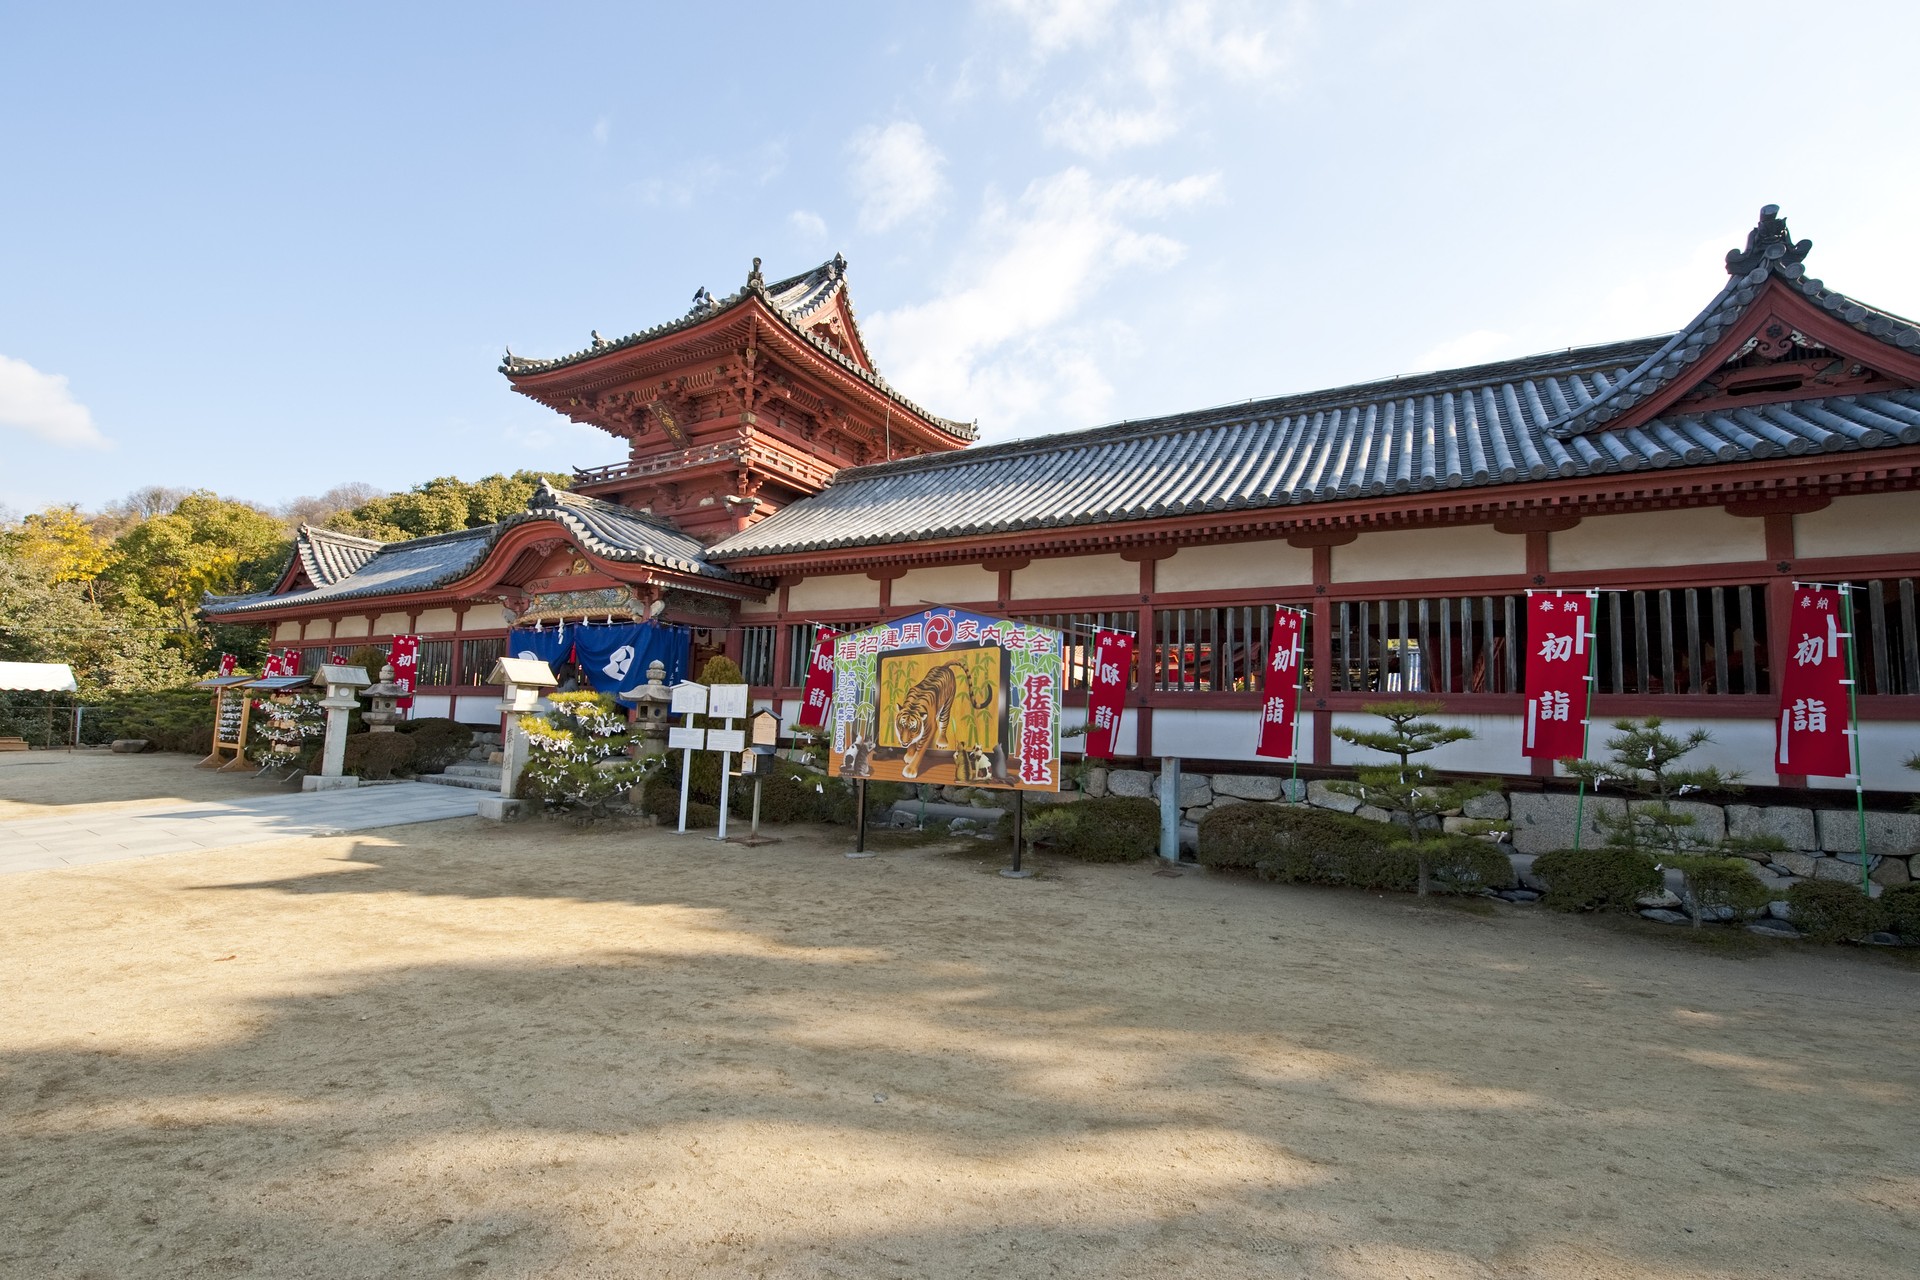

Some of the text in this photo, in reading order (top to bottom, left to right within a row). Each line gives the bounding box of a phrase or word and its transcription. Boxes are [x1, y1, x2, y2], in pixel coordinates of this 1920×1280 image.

[1539, 600, 1578, 612] 奉納
[1800, 595, 1829, 610] 奉納
[956, 620, 1053, 654] 家内安全
[847, 671, 856, 721] 平成二十二年
[1266, 645, 1291, 724] 初詣
[1537, 632, 1574, 722] 初詣
[1792, 632, 1827, 733] 初詣
[1021, 673, 1052, 783] 伊佐爾波神社
